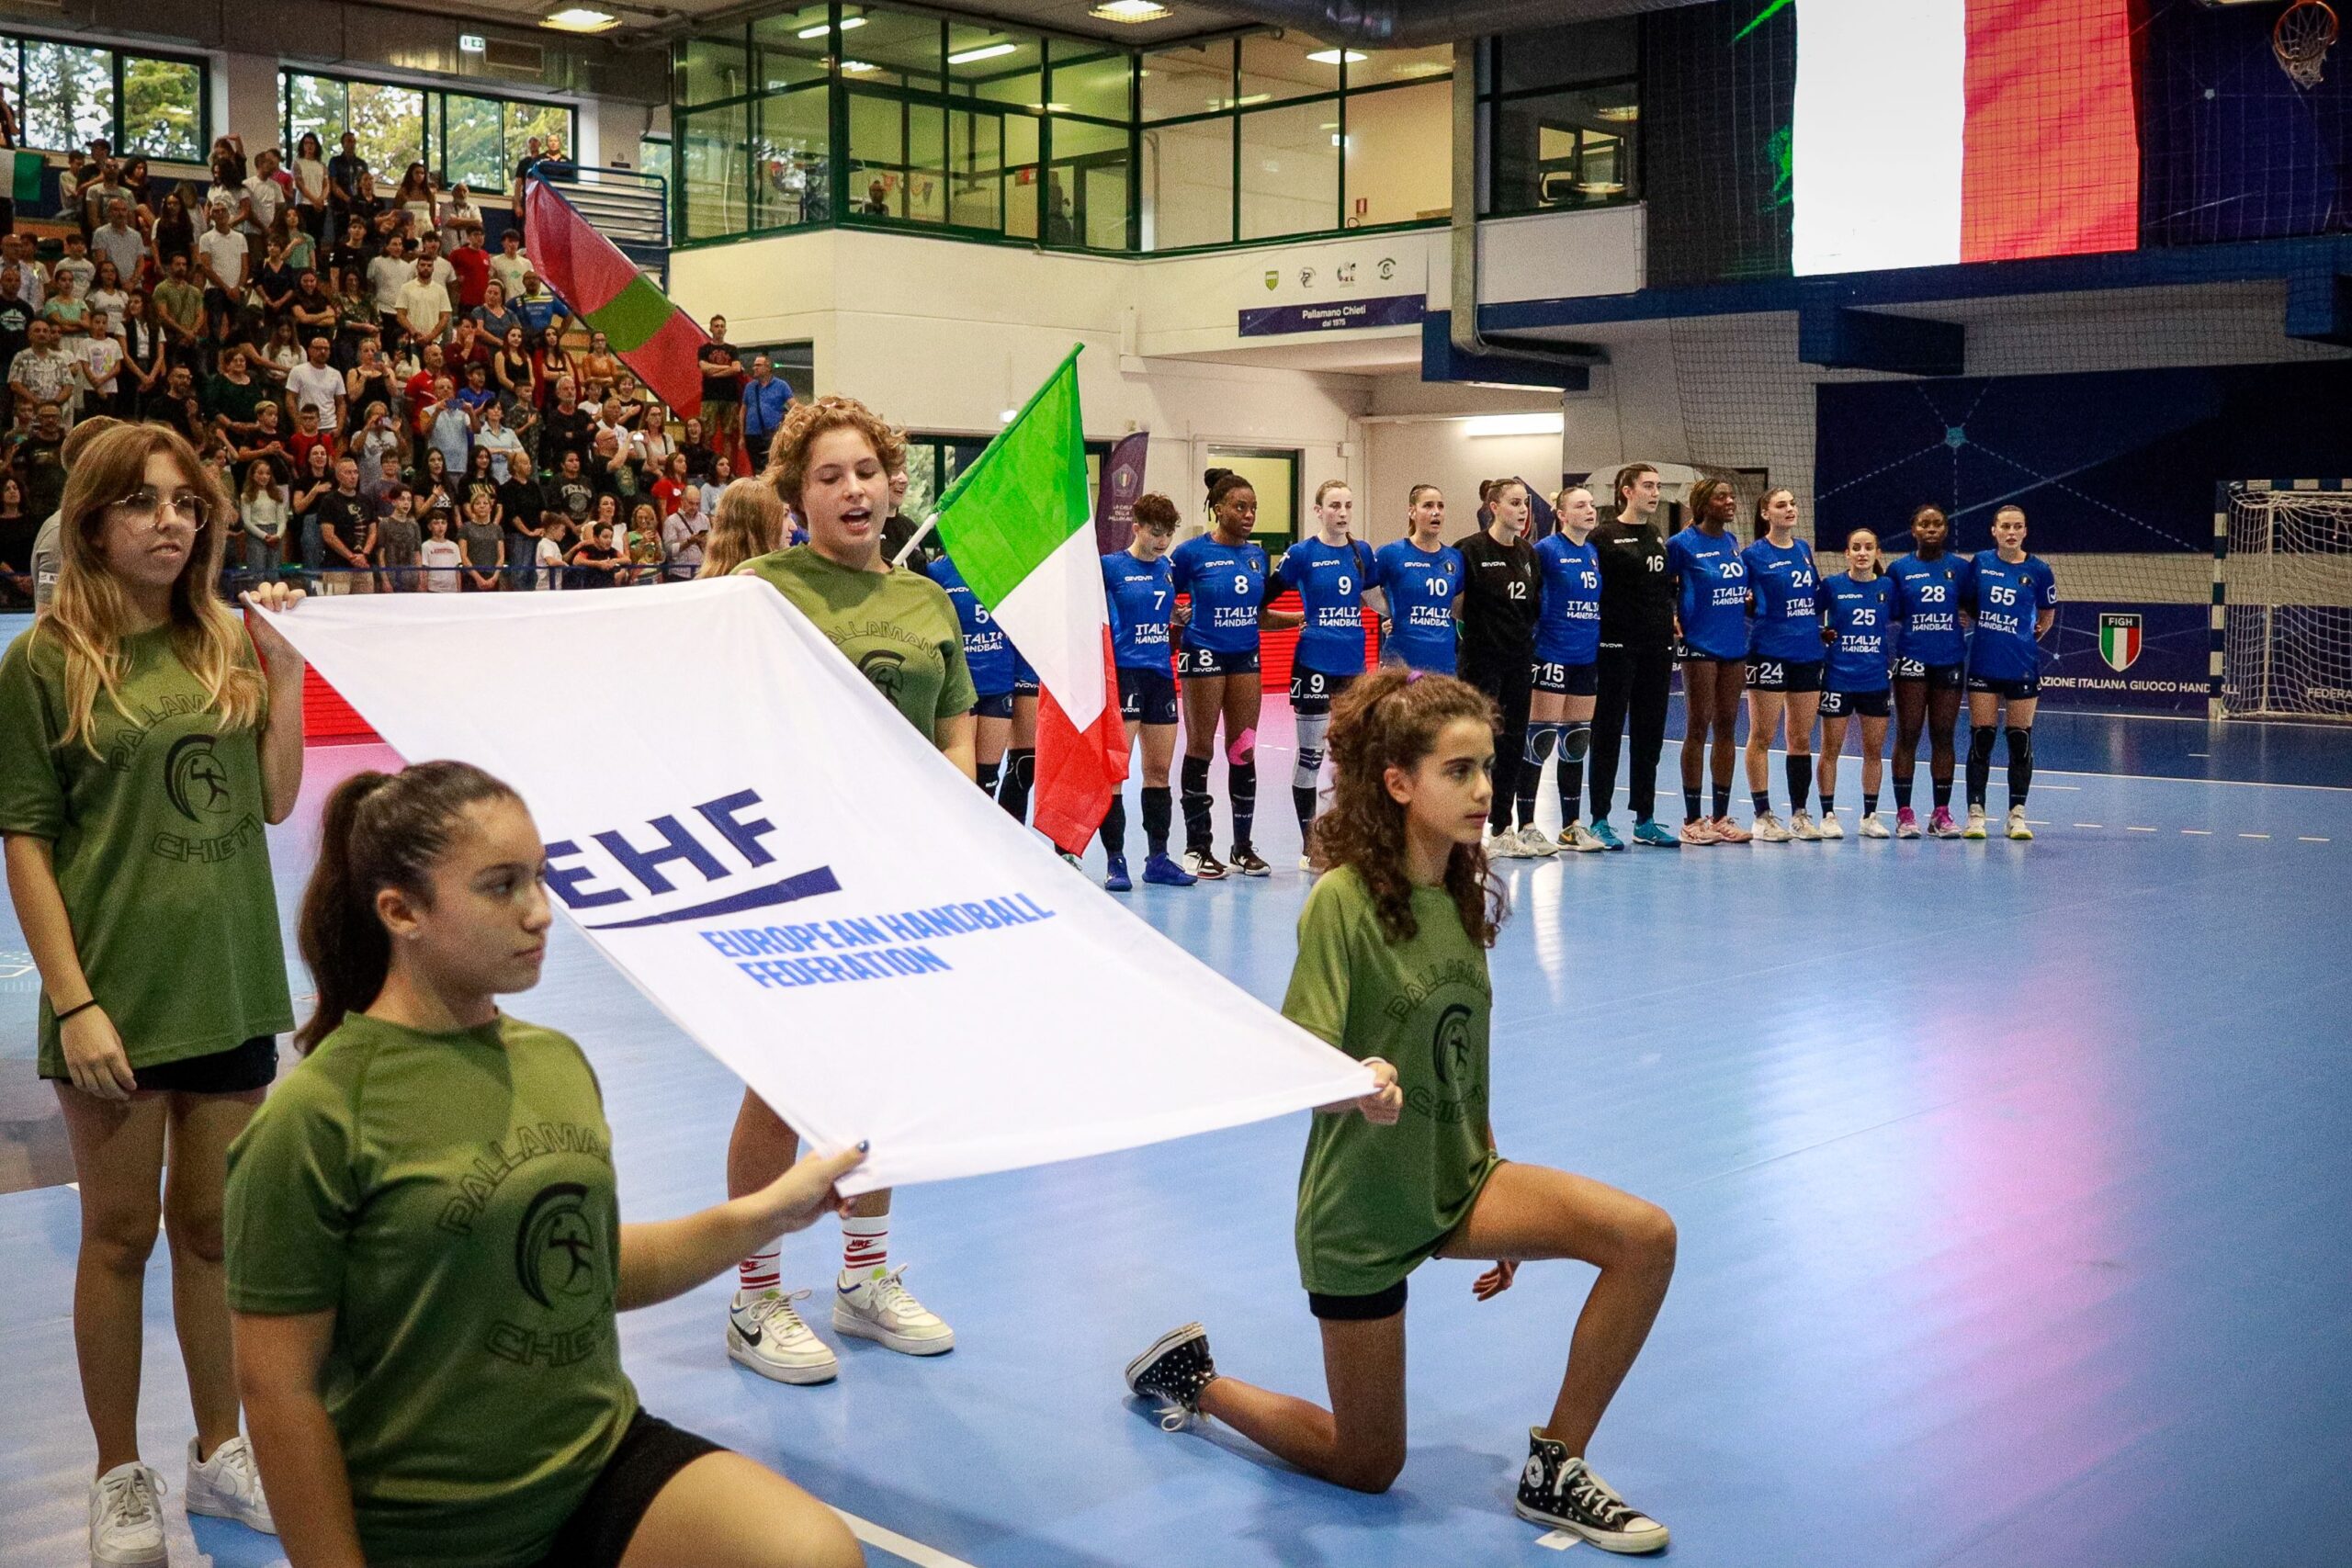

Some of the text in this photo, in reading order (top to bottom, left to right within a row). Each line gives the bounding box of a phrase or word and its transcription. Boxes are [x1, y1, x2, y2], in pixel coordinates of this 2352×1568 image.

[1302, 304, 1366, 319] Pallamano Chieti
[1204, 559, 1235, 568] GIVOVA
[1312, 559, 1340, 568] GIVOVA
[1645, 555, 1664, 572] 16
[1719, 562, 1744, 579] 20
[1769, 560, 1792, 570] GIVOVA
[1580, 571, 1598, 589] 15
[1792, 570, 1813, 588] 24
[1981, 569, 2005, 578] GIVOVA
[1234, 574, 1249, 594] 8
[1338, 576, 1352, 596] 9
[1425, 577, 1448, 597] 10
[1507, 581, 1527, 600] 12
[1153, 591, 1167, 610] 7
[1920, 586, 1946, 603] 28
[1989, 585, 2017, 606] 55
[1214, 606, 1258, 618] ITALIA
[1851, 608, 1876, 626] 25
[1912, 613, 1953, 624] ITALIA
[1979, 610, 2019, 627] ITALIA
[1912, 623, 1954, 632] HANDBALL
[1978, 620, 2018, 635] HANDBALL
[2108, 616, 2133, 627] FIGH
[824, 621, 944, 673] ALLAMANO
[963, 642, 1003, 653] ANDBALL
[1841, 635, 1883, 646] ITALIA
[1199, 649, 1214, 666] 8
[1543, 662, 1565, 682] 15
[1759, 662, 1784, 679] 24
[1310, 673, 1325, 694] 9
[2078, 677, 2127, 690] ITALIANA
[2130, 680, 2177, 693] GIUOCO
[2179, 682, 2240, 695] HANDALL
[1821, 691, 1842, 709] 25
[545, 788, 778, 909] EHF
[698, 891, 1057, 959] EUROPEAN HANDBALL
[734, 945, 954, 989] FEDERATION
[851, 1239, 873, 1248] NIKE
